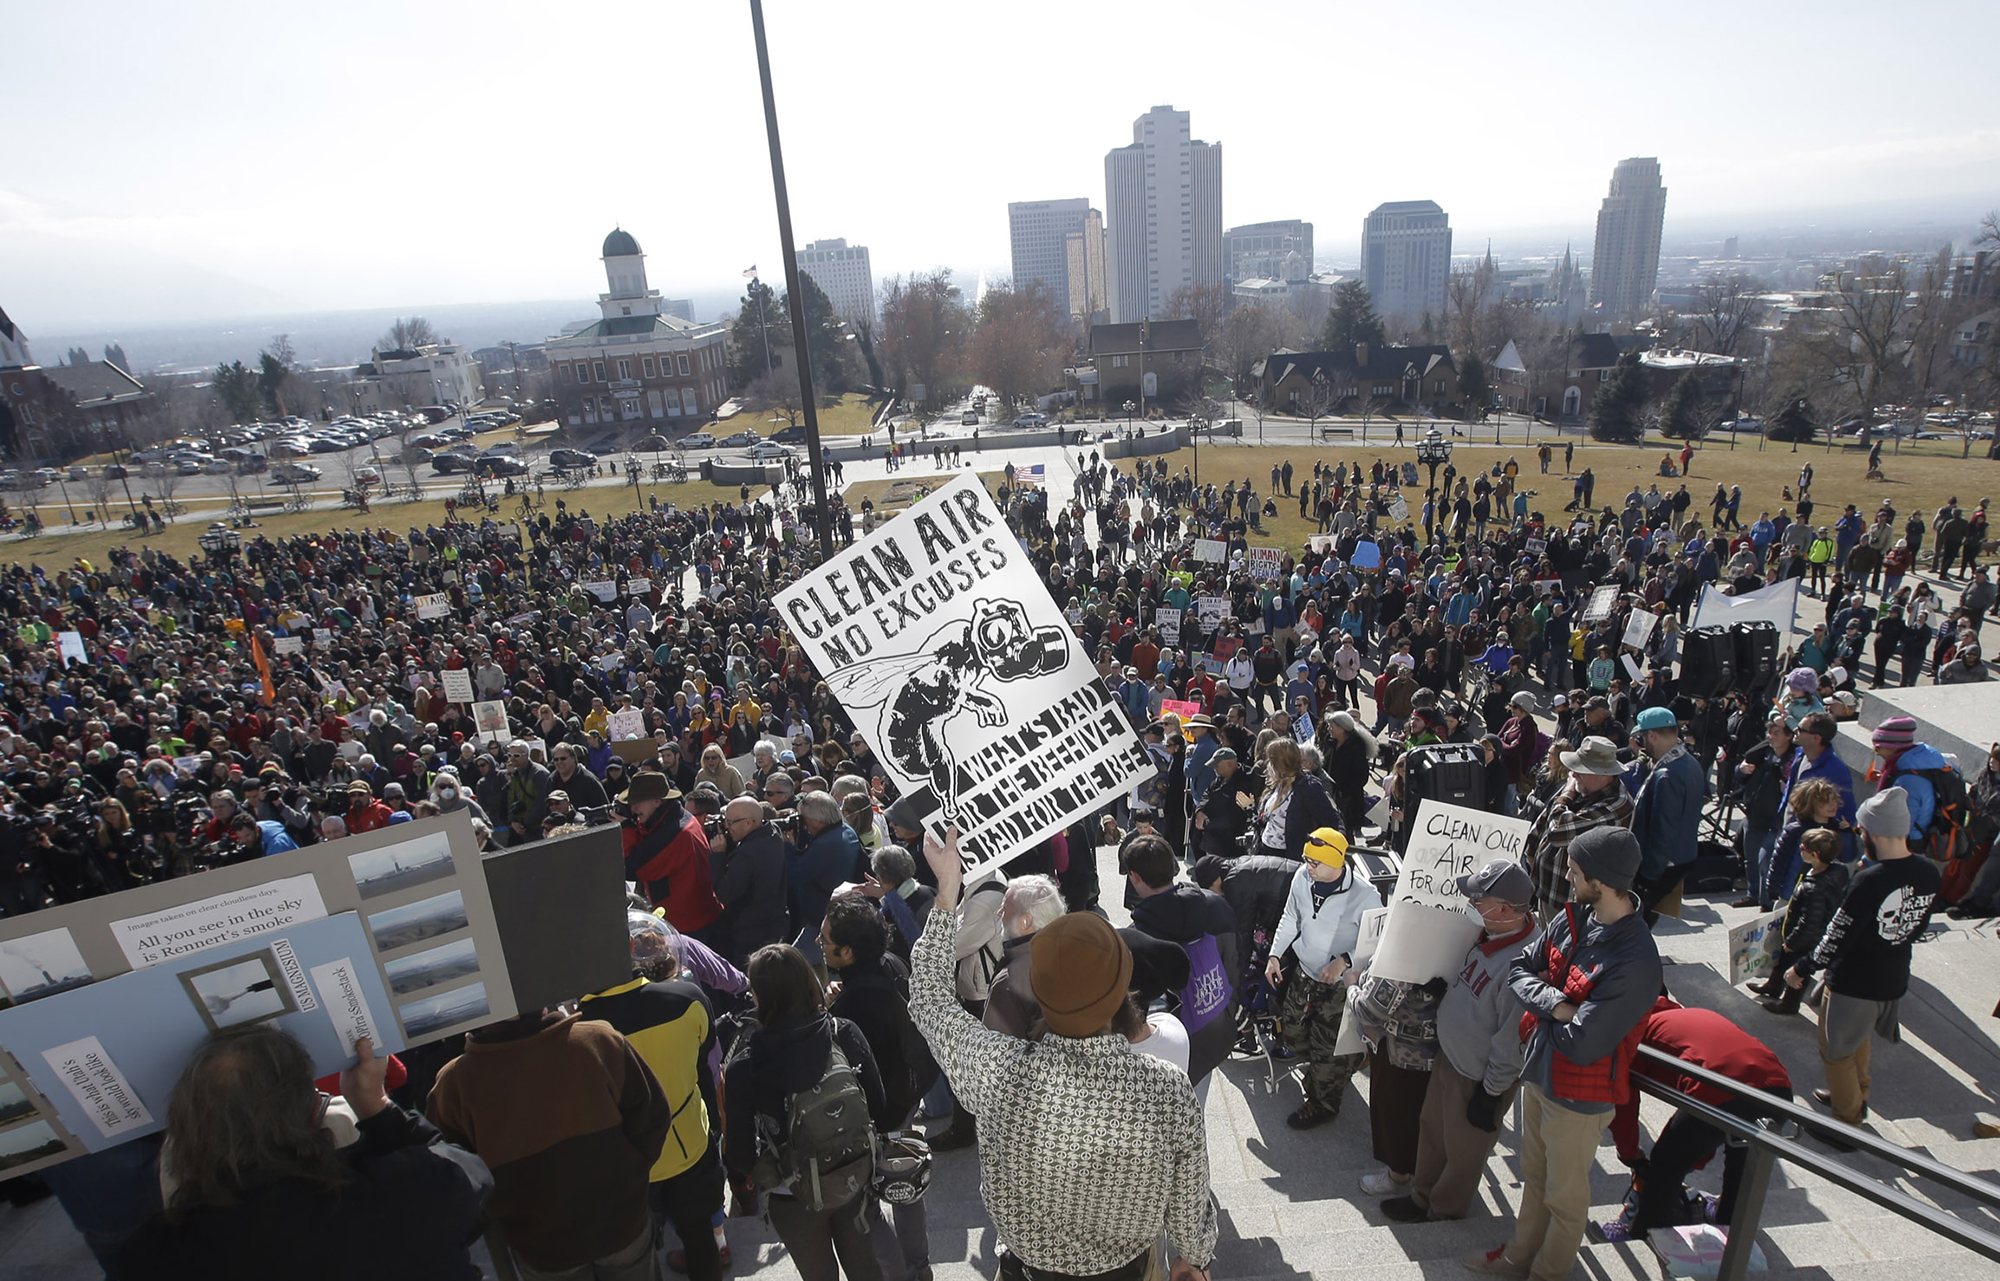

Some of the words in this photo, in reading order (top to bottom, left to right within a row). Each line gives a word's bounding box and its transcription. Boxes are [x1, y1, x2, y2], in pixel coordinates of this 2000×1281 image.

[787, 537, 915, 640] CLEAN
[913, 489, 995, 566] AIR
[1250, 548, 1280, 562] HUMAN
[820, 624, 873, 669] NO
[873, 538, 1008, 640] EXCUSES
[962, 716, 1052, 785] WHAT'S
[1052, 685, 1103, 735] BAD
[934, 799, 987, 847] FOR
[984, 766, 1034, 815] THE
[1031, 710, 1120, 784] BEEHIVE
[977, 812, 1021, 858] BAD
[1022, 797, 1069, 836] FOR
[1060, 763, 1107, 807] THE
[1107, 744, 1152, 784] BEE
[1426, 814, 1482, 843] CLEAN
[1485, 829, 1522, 859] OUR
[1433, 842, 1475, 876] AIR
[1409, 869, 1434, 895] FOR
[1440, 878, 1461, 898] OU
[127, 920, 159, 931] Images
[160, 912, 184, 923] taken
[198, 903, 218, 913] clear
[220, 894, 258, 907] cloudless
[138, 935, 161, 950] All
[164, 929, 196, 945] you
[198, 920, 226, 933] see
[227, 915, 245, 925] in
[247, 907, 274, 920] the
[277, 899, 302, 912] sky
[142, 952, 158, 962] is
[161, 930, 240, 957] Rennert's
[243, 915, 293, 935] smoke
[273, 940, 313, 999] MAGNESIUM
[300, 998, 316, 1012] US
[62, 1058, 90, 1086] Utah's
[85, 1052, 104, 1071] like
[93, 1067, 115, 1086] look
[82, 1083, 102, 1104] what
[96, 1102, 111, 1113] is
[104, 1083, 130, 1108] would
[102, 1109, 121, 1128] This
[125, 1106, 142, 1120] sky
